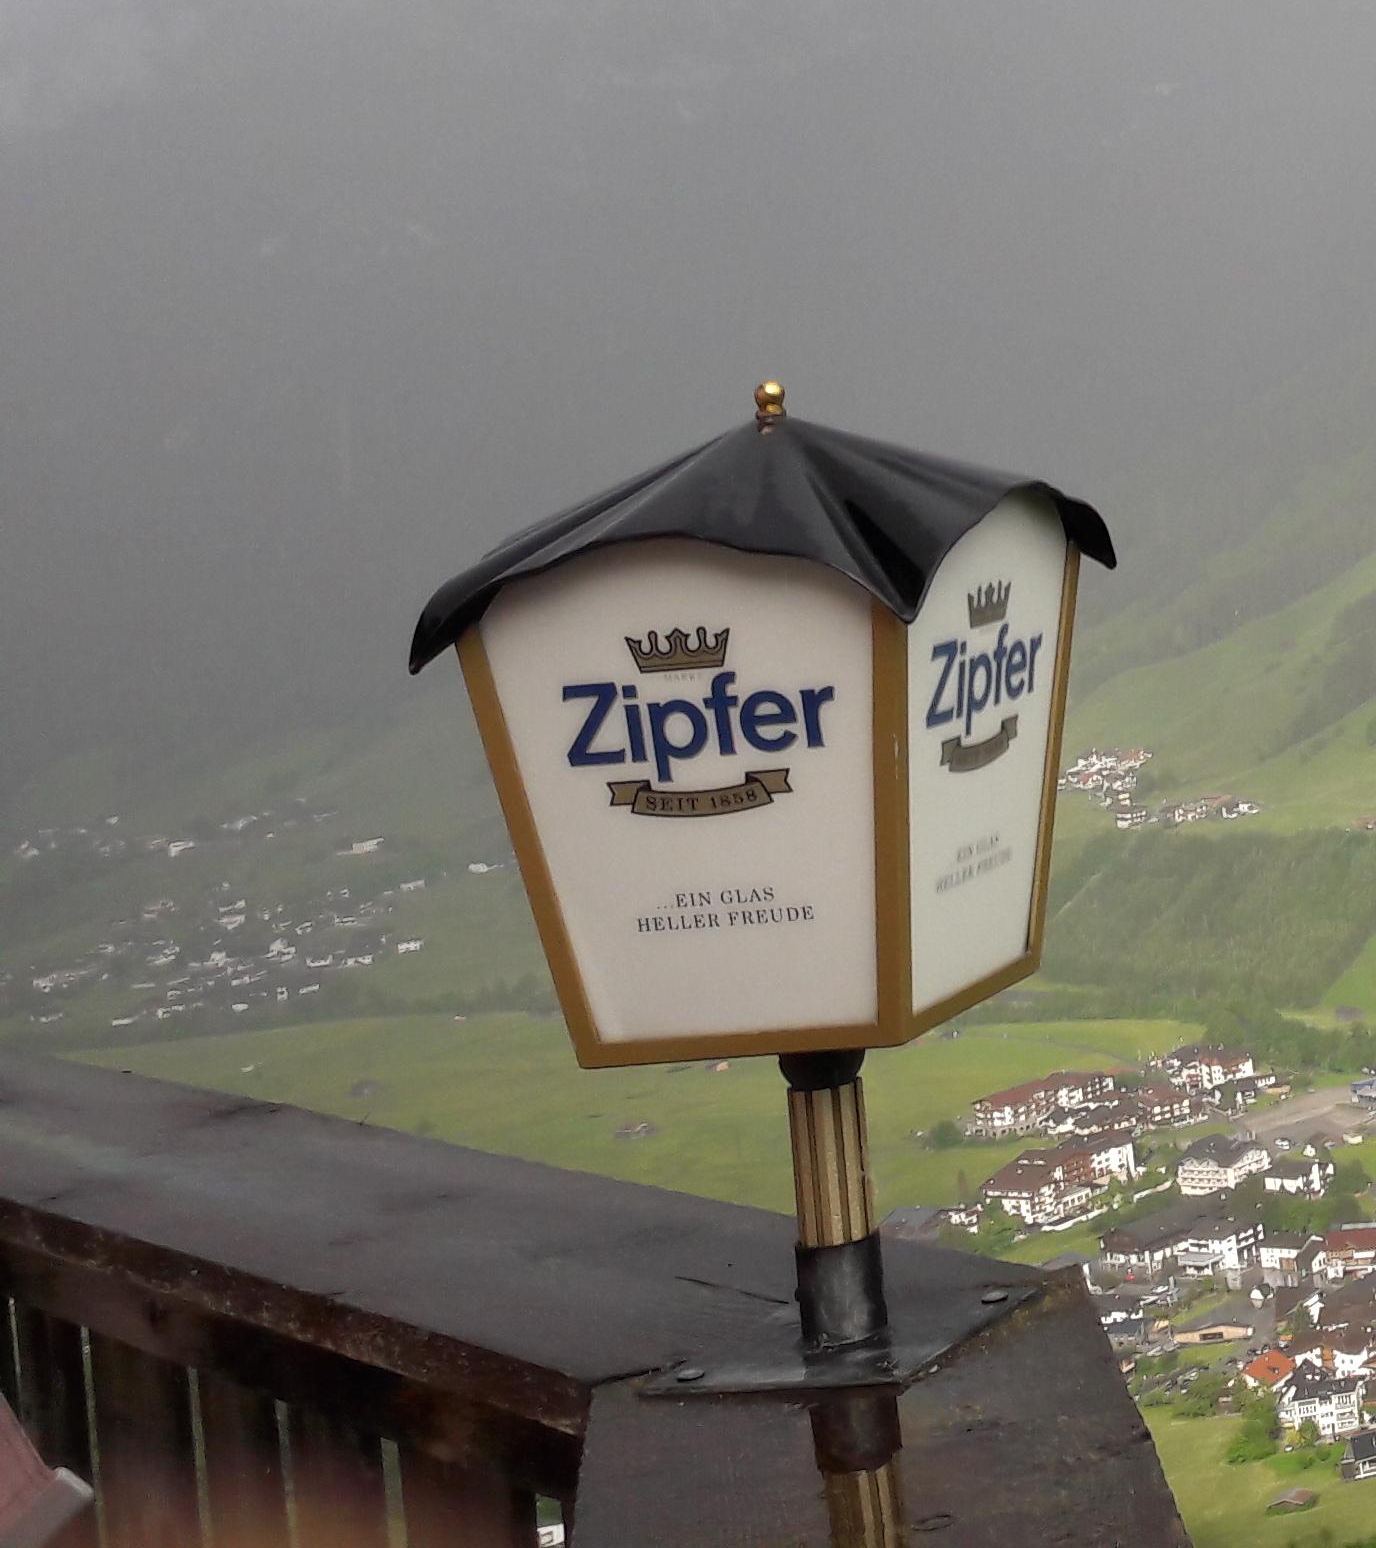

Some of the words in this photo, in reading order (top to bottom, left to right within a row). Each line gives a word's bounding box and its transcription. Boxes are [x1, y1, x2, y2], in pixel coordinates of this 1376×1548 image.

[926, 623, 1043, 738] Zipfer
[562, 671, 835, 783] Zipfer
[645, 796, 700, 813] SEIT
[710, 789, 758, 809] 1858
[720, 886, 776, 905] GLAS
[637, 913, 720, 933] HELLER
[728, 905, 815, 927] FREUDE
